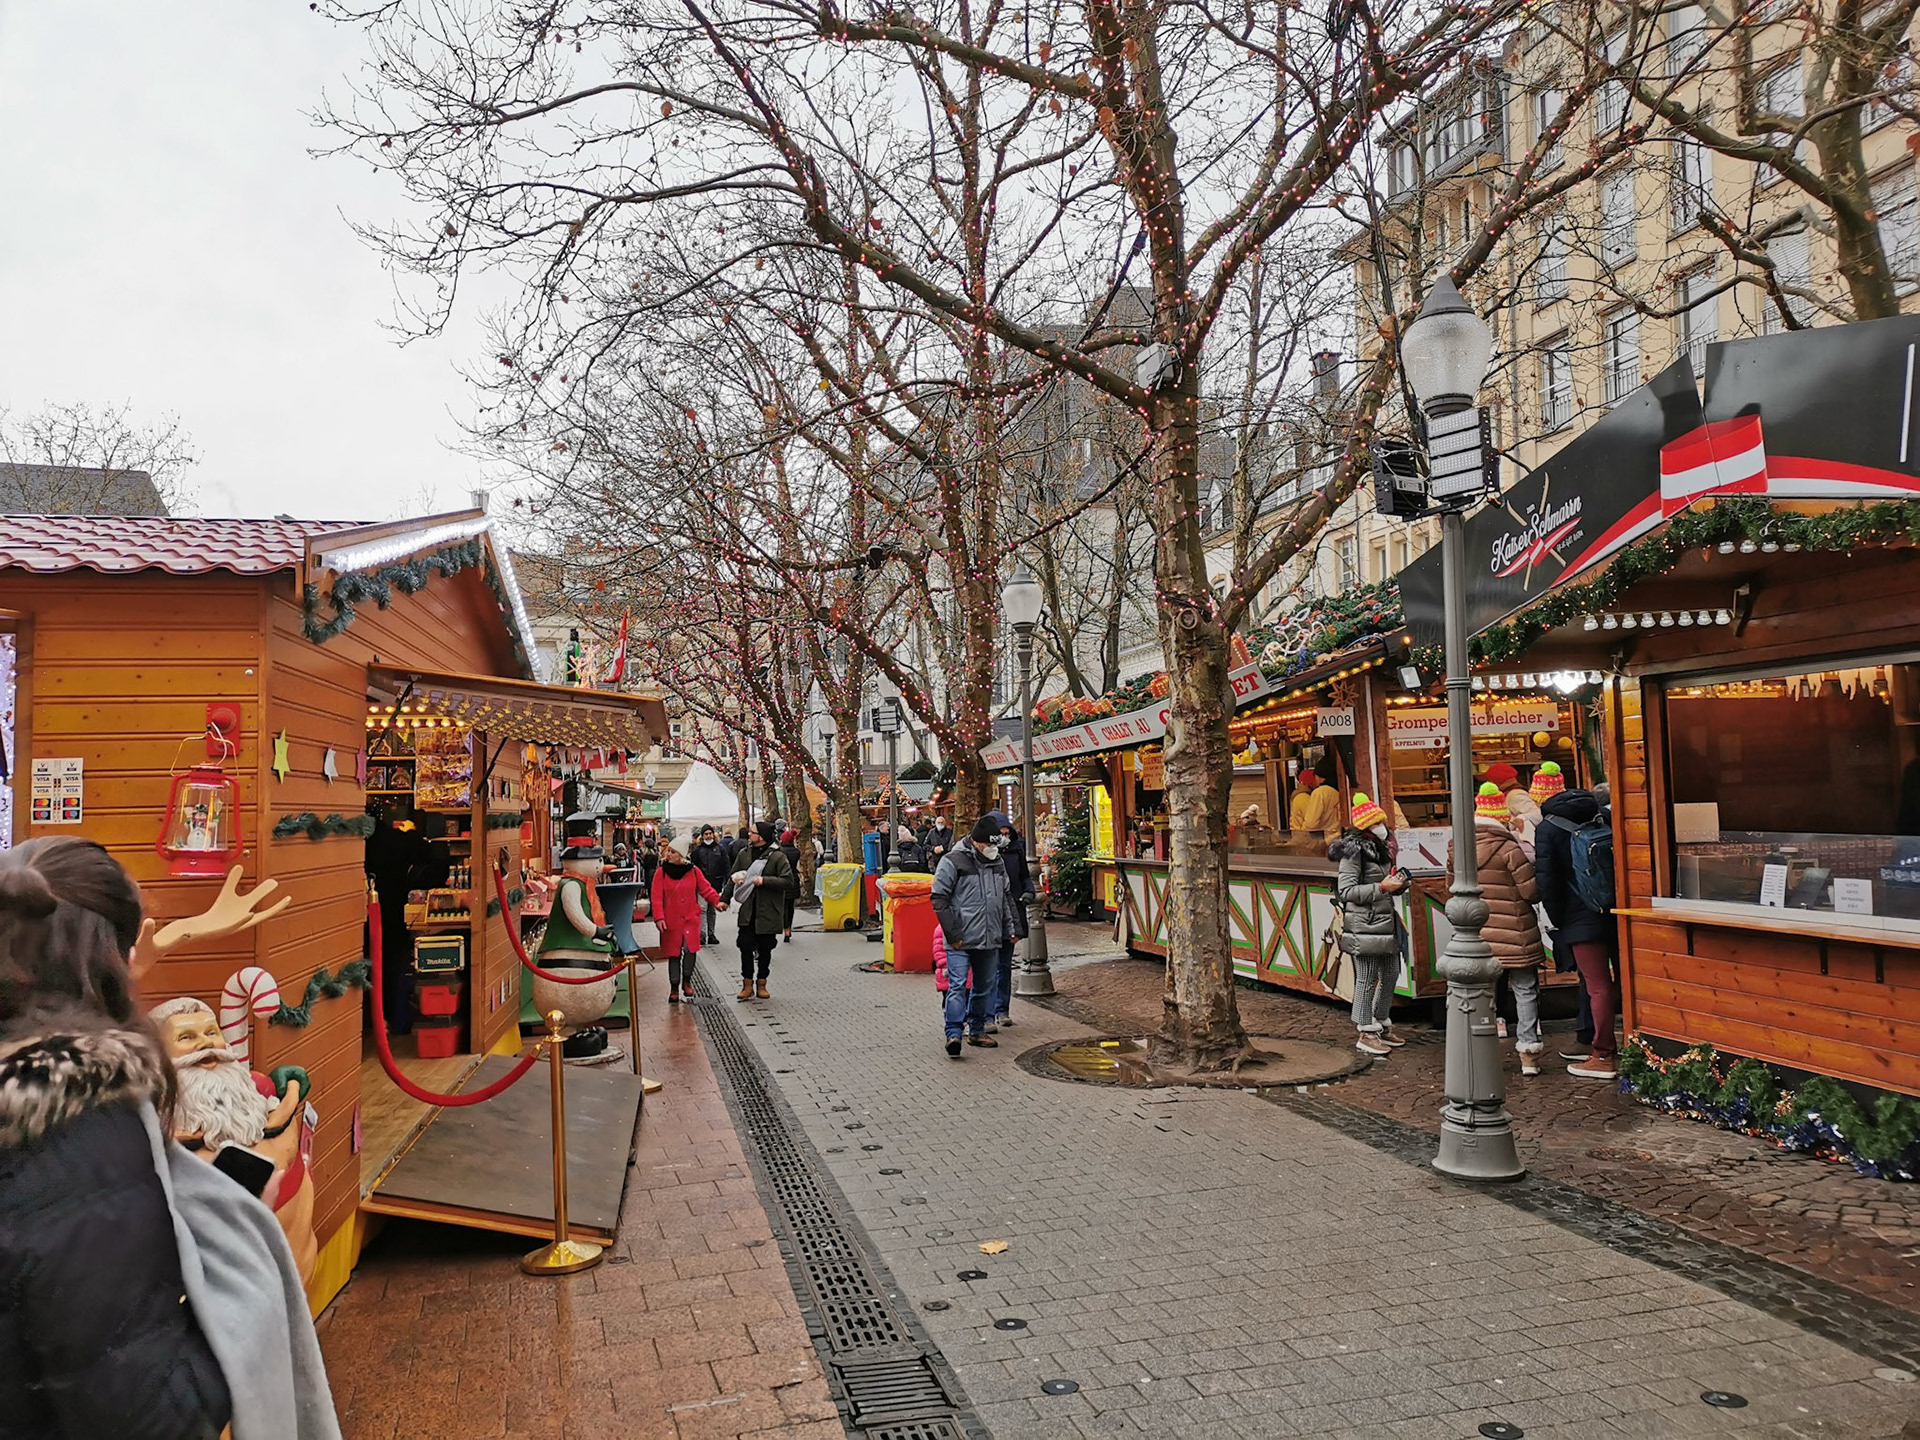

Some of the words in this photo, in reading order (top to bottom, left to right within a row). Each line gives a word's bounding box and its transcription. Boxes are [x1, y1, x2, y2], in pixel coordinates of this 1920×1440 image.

[1101, 722, 1134, 742] CHALET
[1136, 717, 1151, 734] AU
[1320, 714, 1351, 727] A008
[1387, 710, 1543, 731] Grompeichelcher
